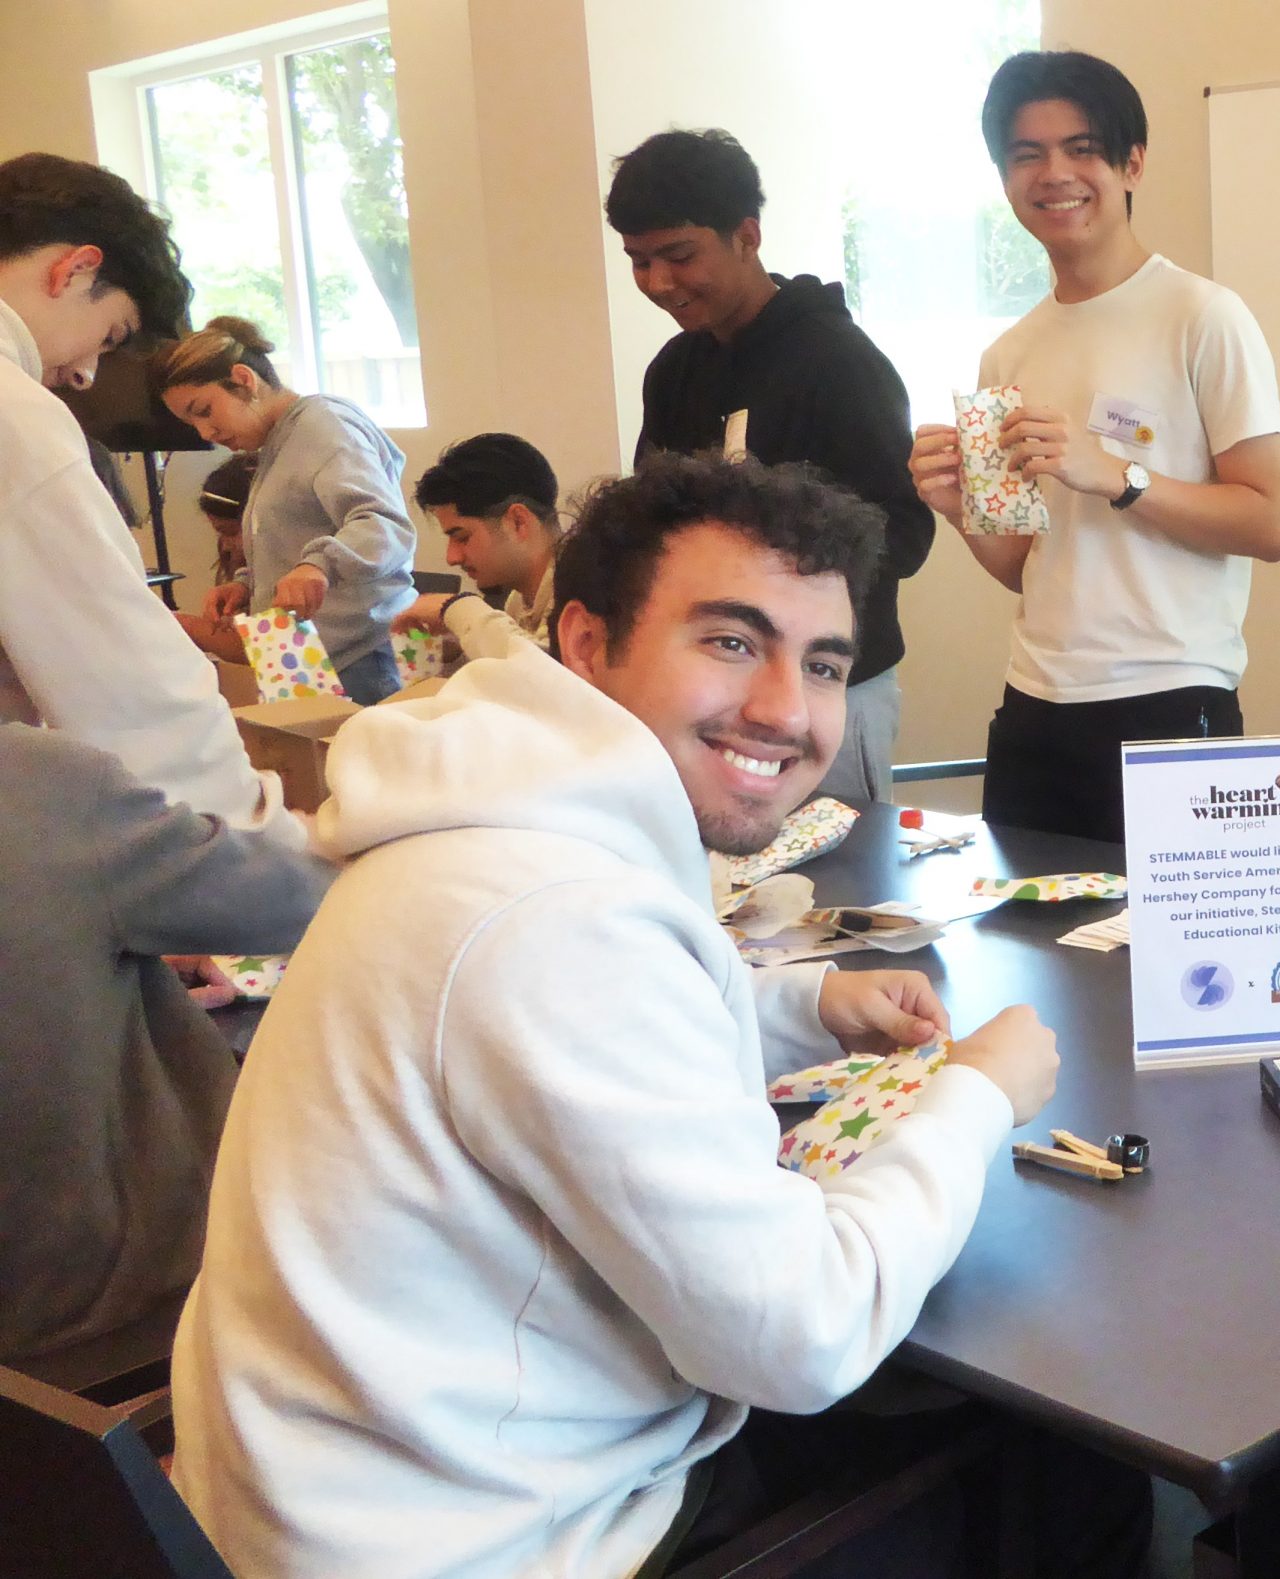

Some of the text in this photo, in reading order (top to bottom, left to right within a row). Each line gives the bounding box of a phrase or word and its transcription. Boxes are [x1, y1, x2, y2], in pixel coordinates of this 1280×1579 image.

[1107, 411, 1140, 427] Wyatt
[1190, 785, 1276, 805] the heart
[1223, 818, 1265, 833] project
[1149, 849, 1227, 864] STEMMABLE
[1230, 845, 1271, 859] would
[1150, 869, 1191, 884] Youth
[1193, 867, 1243, 881] Service
[1142, 890, 1198, 905] Hershey
[1201, 886, 1267, 902] Company
[1169, 911, 1193, 922] our
[1195, 906, 1259, 921] initiative,
[1183, 925, 1263, 941] Educational
